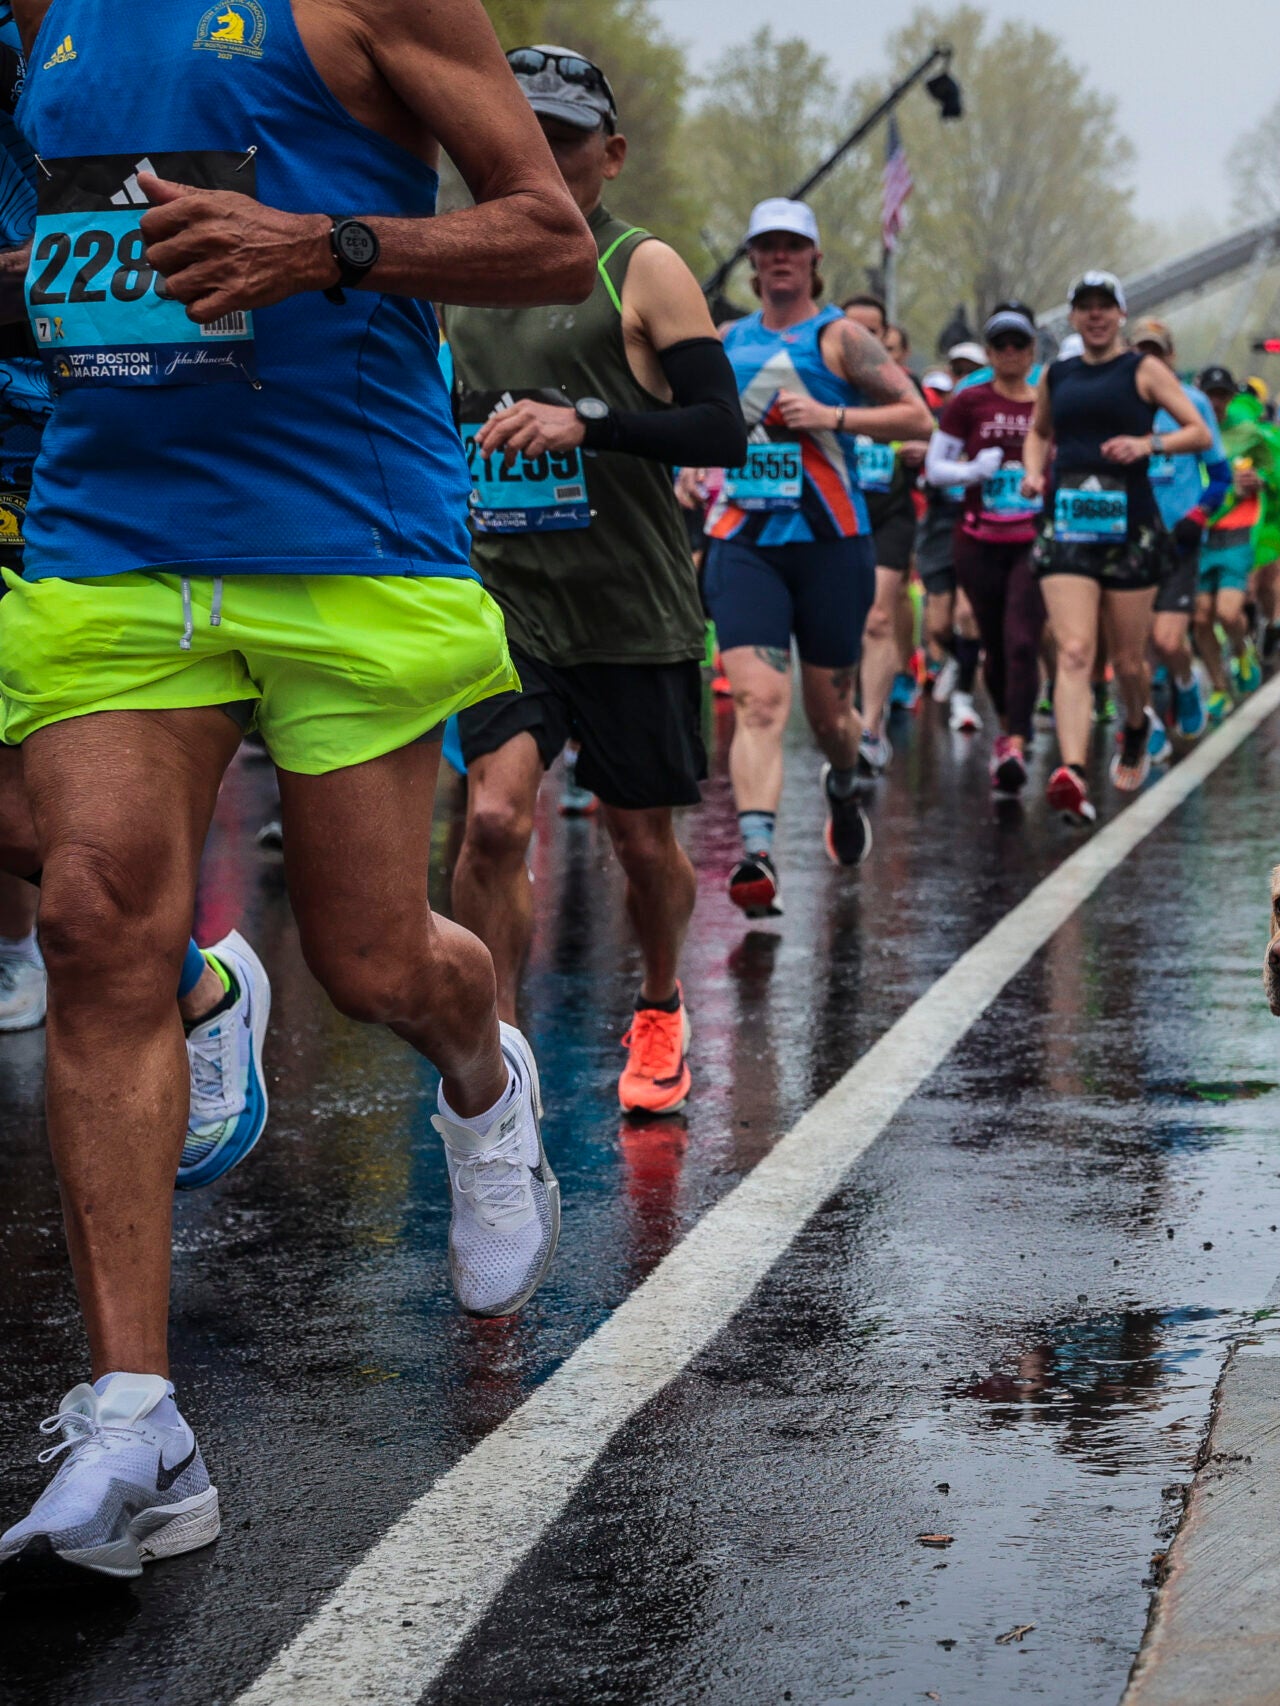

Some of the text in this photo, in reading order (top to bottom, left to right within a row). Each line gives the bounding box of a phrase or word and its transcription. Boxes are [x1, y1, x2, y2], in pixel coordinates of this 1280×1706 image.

[30, 228, 177, 306] 228
[38, 323, 48, 338] 7
[96, 352, 150, 364] BOSTON
[73, 365, 151, 378] MARATHON
